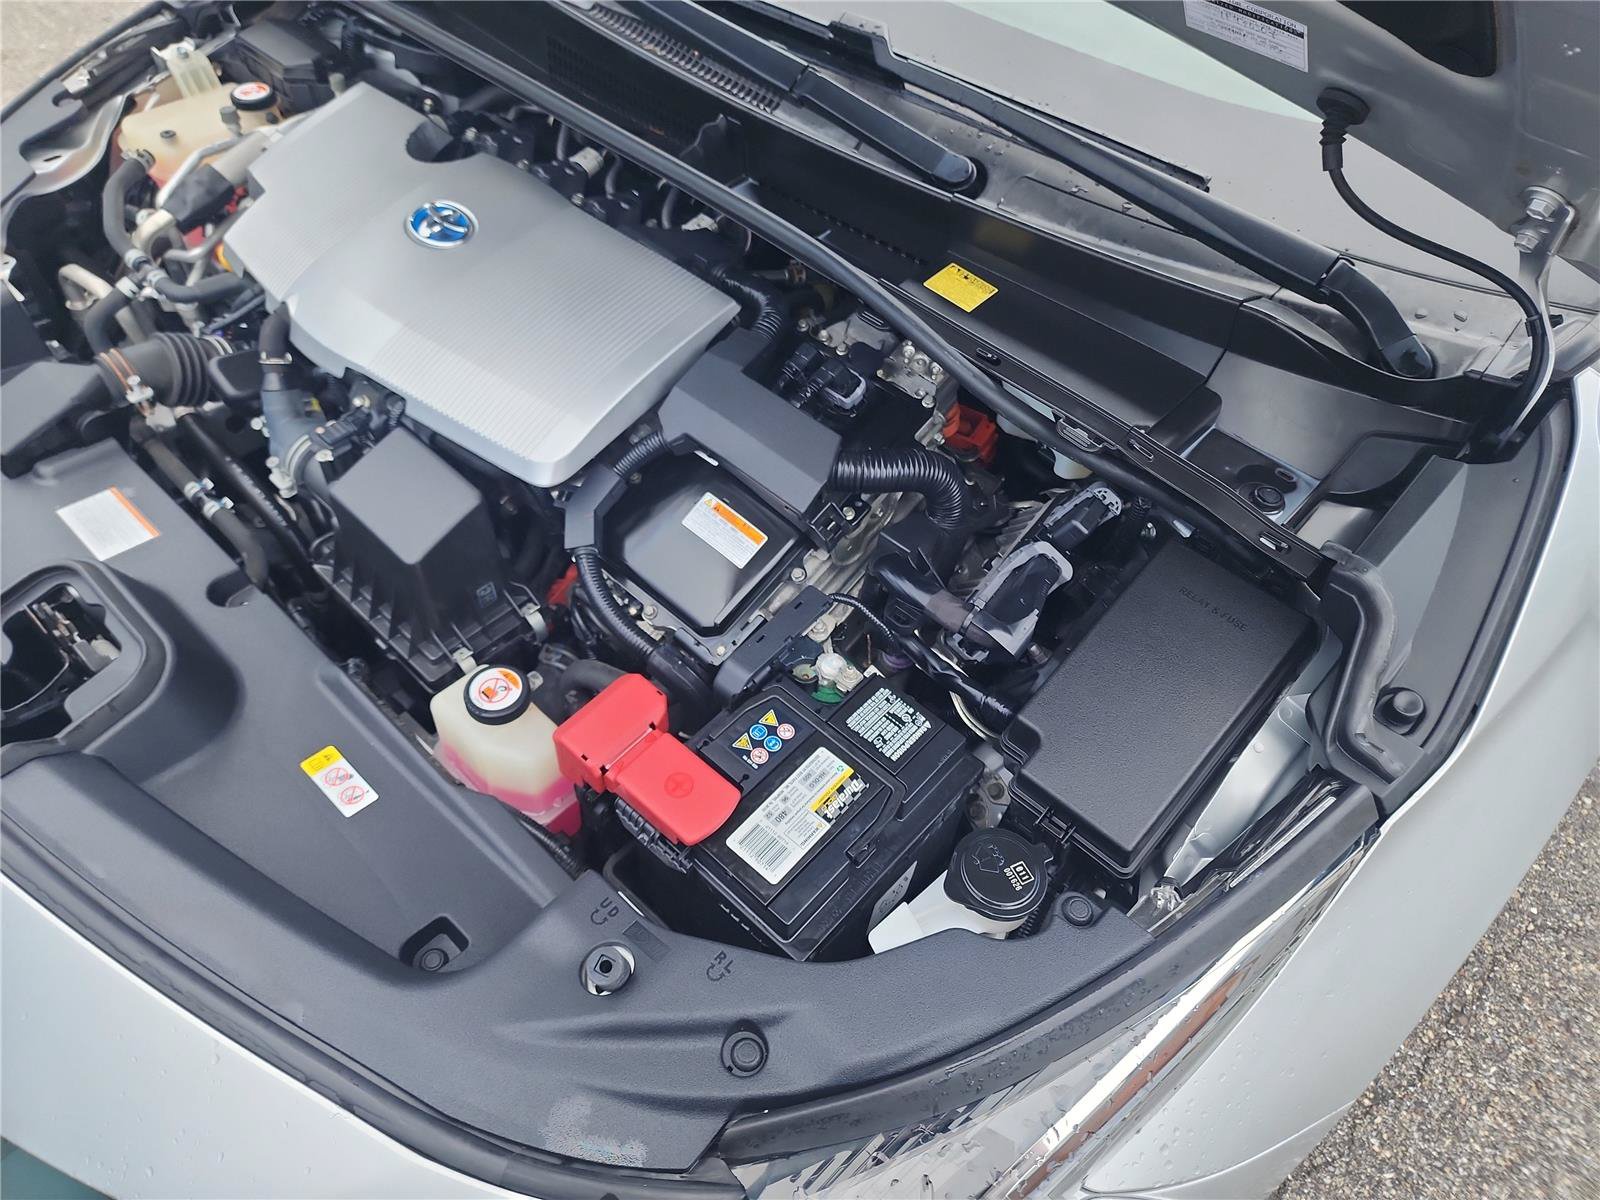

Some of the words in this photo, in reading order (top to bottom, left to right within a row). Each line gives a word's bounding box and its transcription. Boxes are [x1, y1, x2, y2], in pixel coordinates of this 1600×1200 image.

[1238, 8, 1298, 35] MODIFICATIONS
[1246, 5, 1297, 29] CORPORATION
[1220, 611, 1249, 632] FUSE
[823, 779, 862, 819] Duralast
[774, 808, 788, 822] 480
